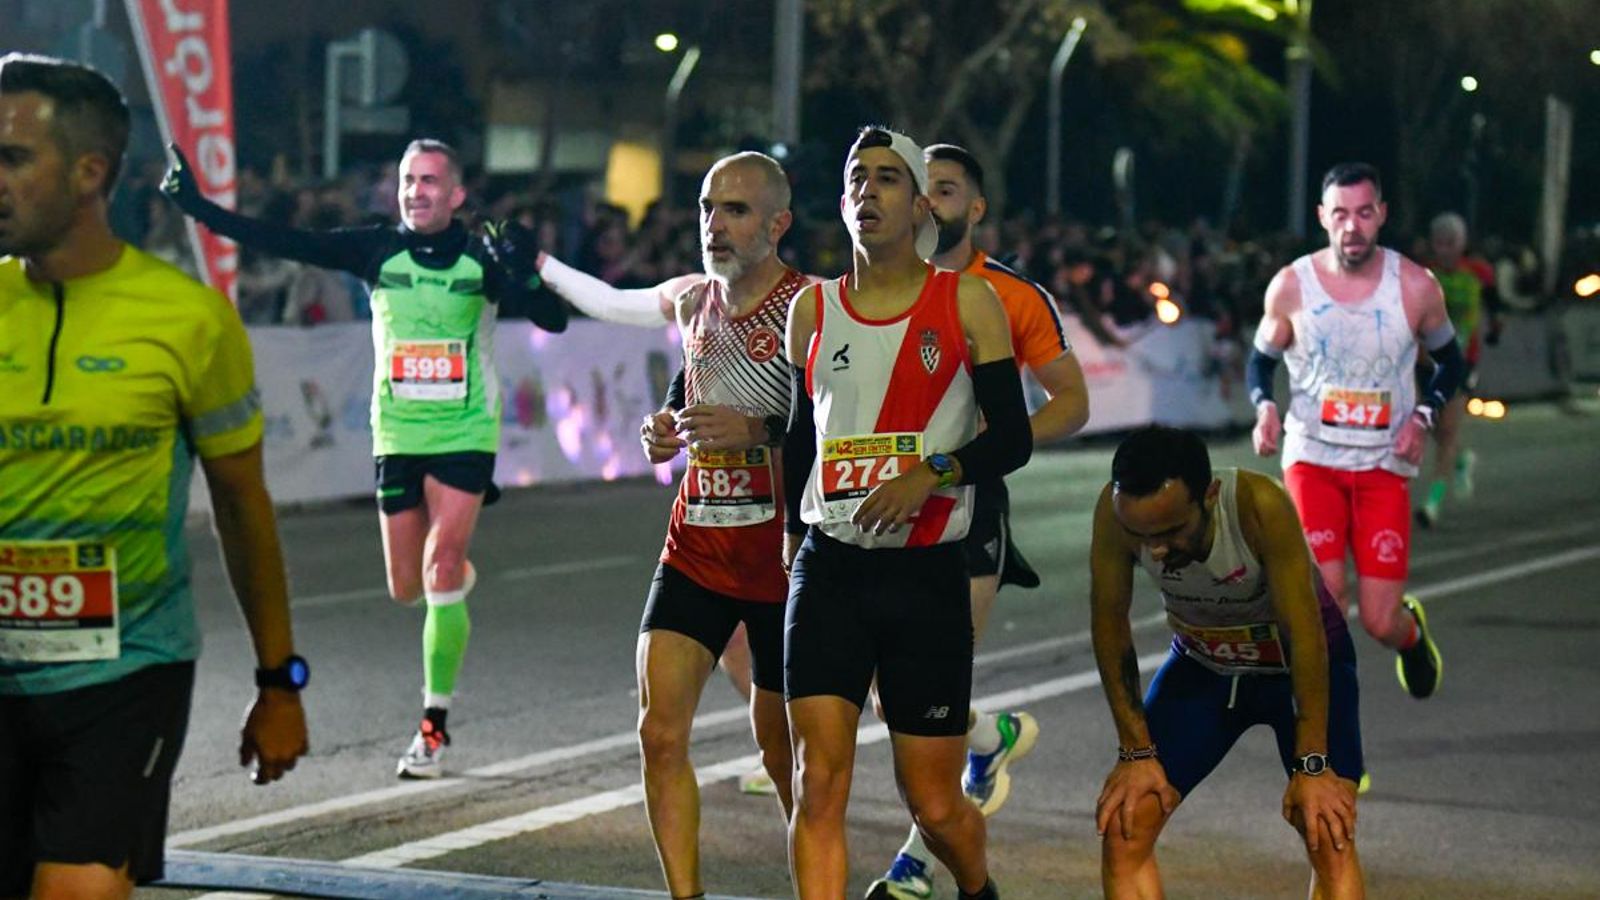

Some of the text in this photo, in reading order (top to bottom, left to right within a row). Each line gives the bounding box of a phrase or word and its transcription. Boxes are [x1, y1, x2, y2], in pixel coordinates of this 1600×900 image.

[403, 357, 451, 379] 599
[1333, 403, 1382, 424] 347
[698, 469, 753, 497] 682
[835, 457, 901, 490] 274
[0, 575, 84, 617] 589
